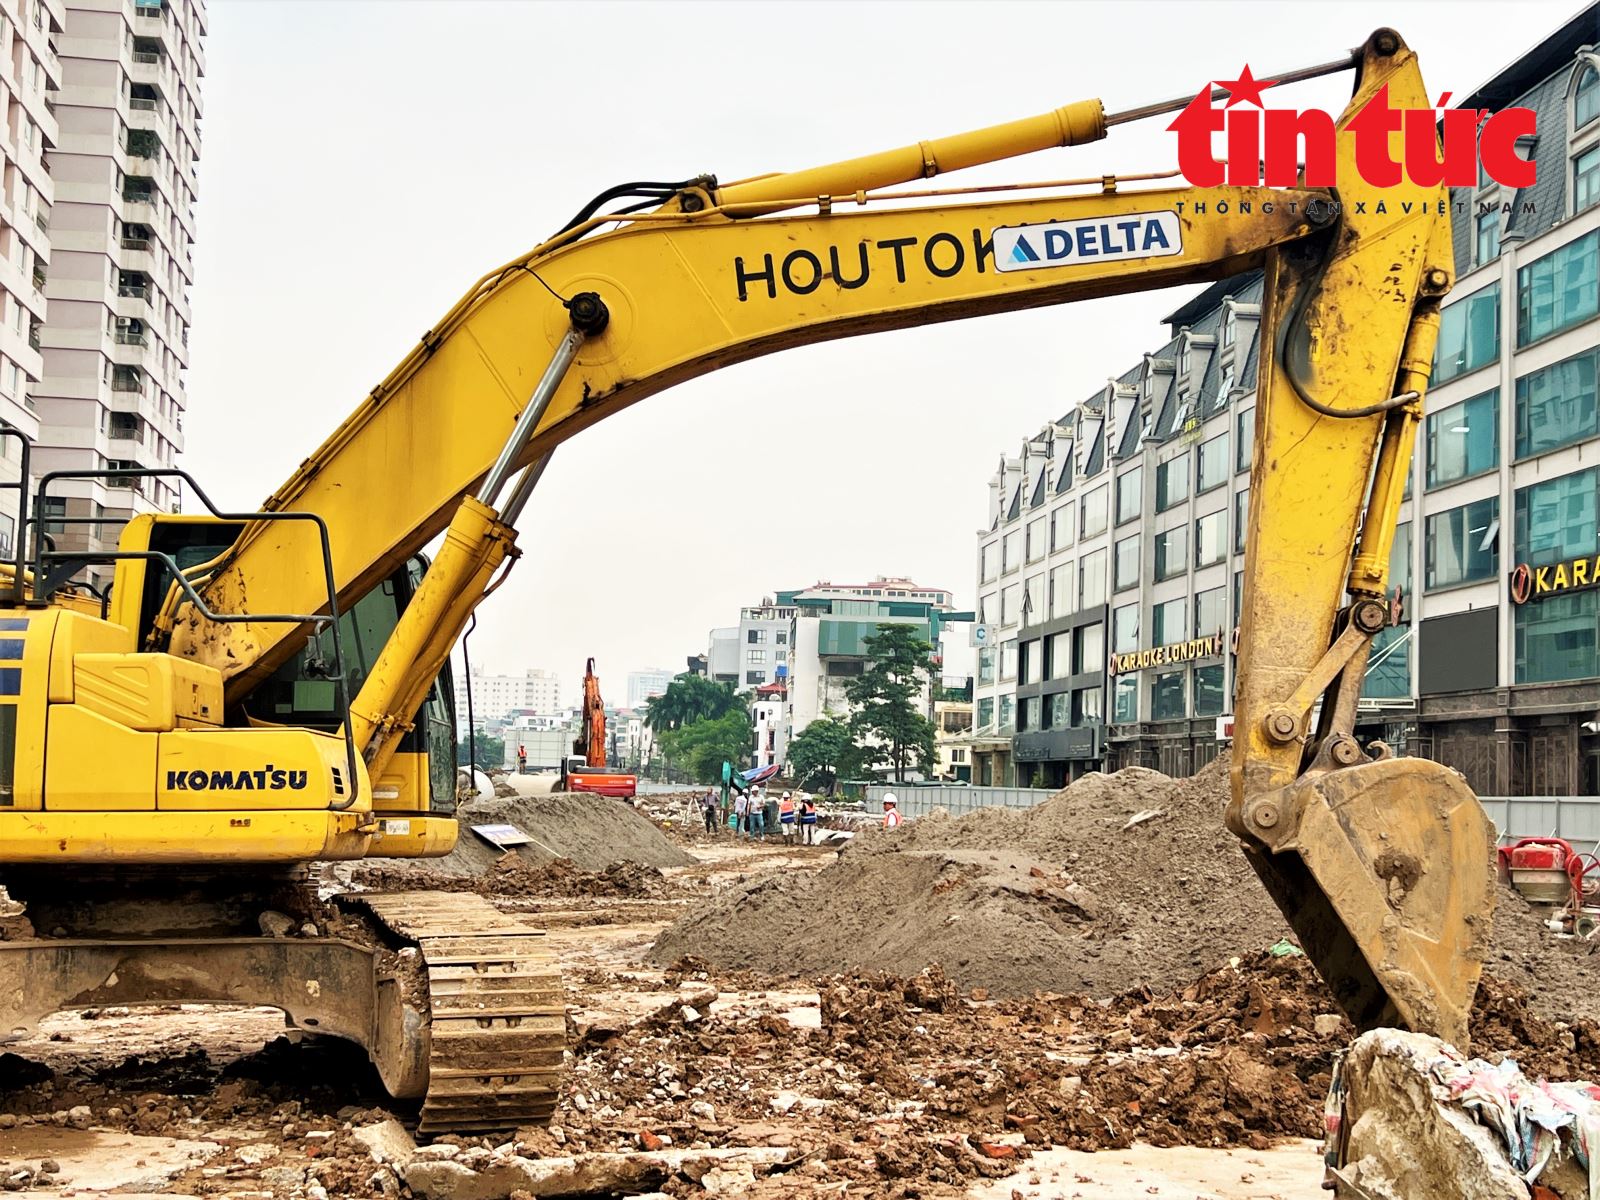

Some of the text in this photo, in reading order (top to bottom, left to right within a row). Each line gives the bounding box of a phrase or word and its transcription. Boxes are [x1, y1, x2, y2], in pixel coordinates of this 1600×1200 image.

[1044, 219, 1170, 260] DELTA
[735, 228, 996, 302] HOUTOK
[1117, 638, 1213, 672] KARAOKE LONDON
[167, 765, 307, 790] KOMATSU
